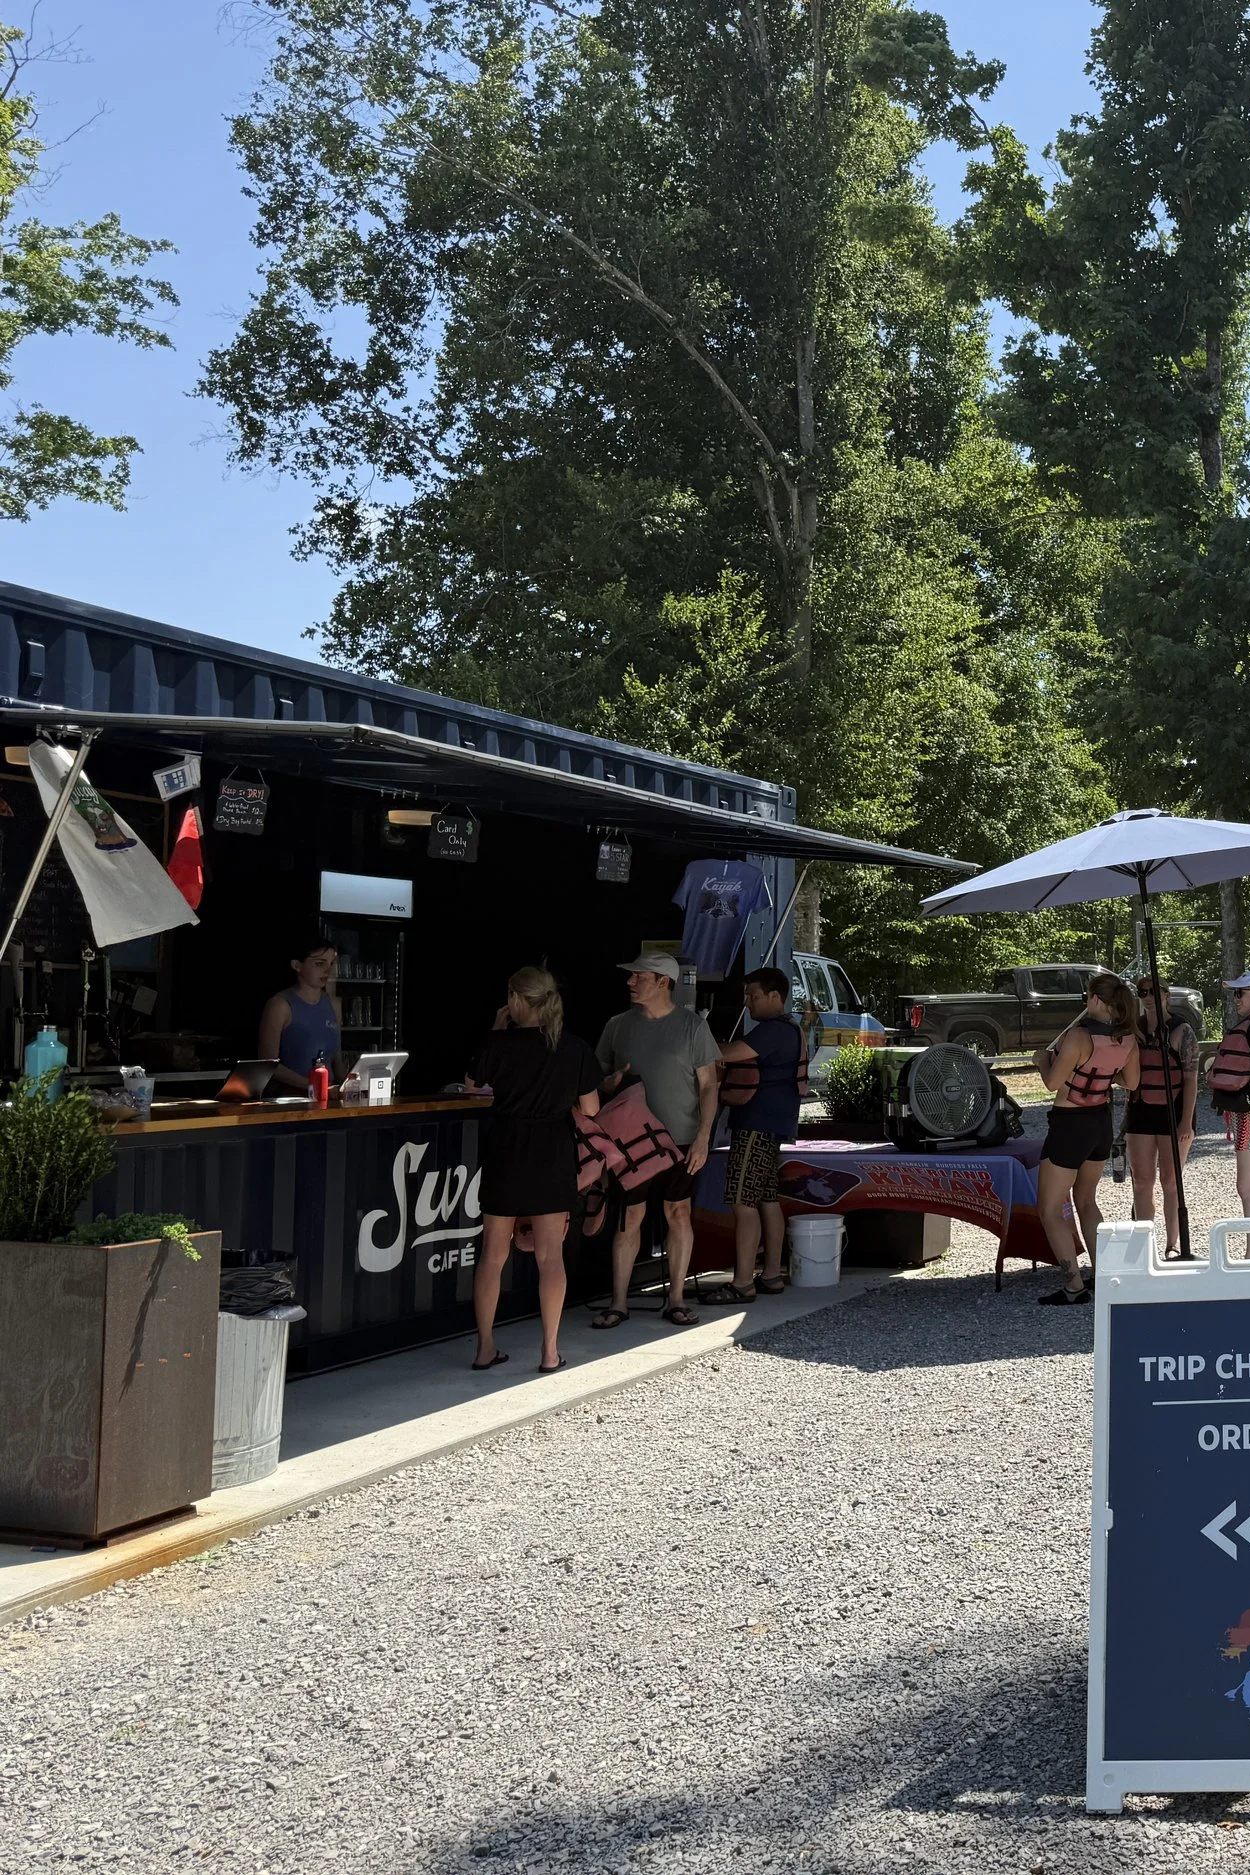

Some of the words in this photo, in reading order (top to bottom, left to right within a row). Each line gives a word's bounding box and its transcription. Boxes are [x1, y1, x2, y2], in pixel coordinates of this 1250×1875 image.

[437, 820, 457, 833] Card
[448, 835, 467, 847] Only
[701, 877, 743, 894] Kayak
[857, 1164, 992, 1181] CUMBERLAND
[865, 1172, 1001, 1201] KAYAK
[427, 1243, 476, 1274] CAFÉ
[1139, 1355, 1206, 1382] TRIP
